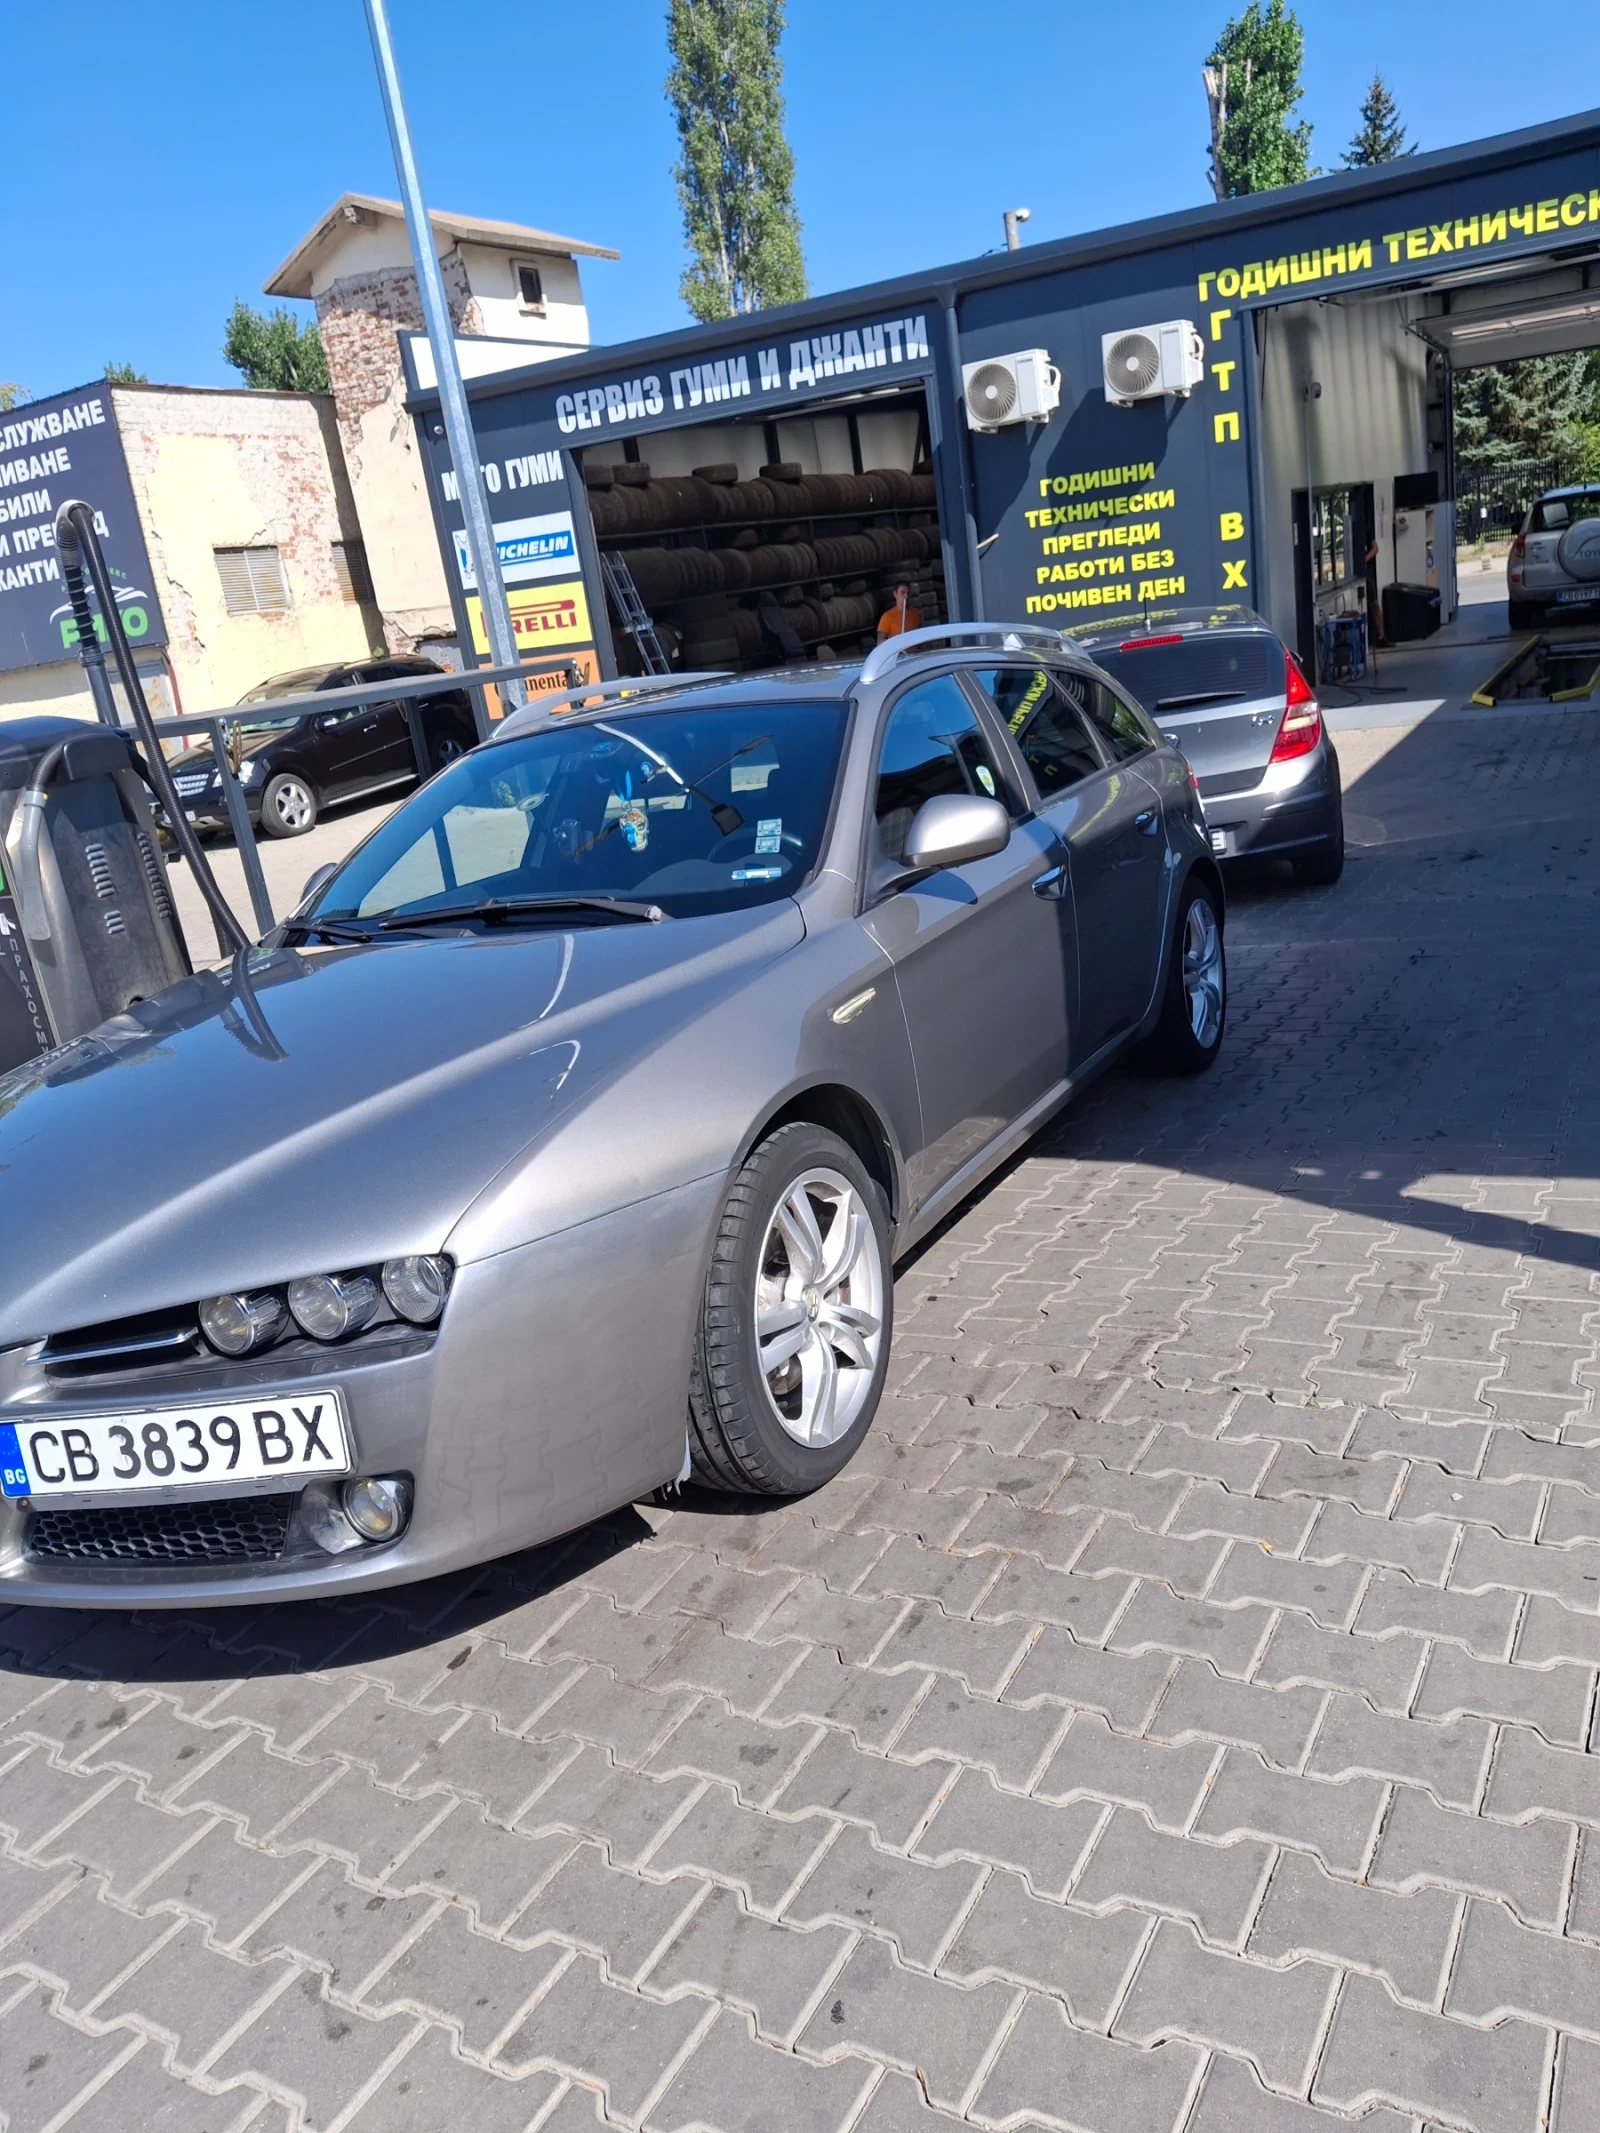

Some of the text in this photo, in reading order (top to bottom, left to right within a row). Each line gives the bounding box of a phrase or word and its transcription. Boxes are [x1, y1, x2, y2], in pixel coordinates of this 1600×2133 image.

[1198, 239, 1372, 302] ГОДИШНИ
[555, 315, 929, 434] СЕРВИЗ ГУМИ И ДЖАНТИ
[0, 447, 71, 487] ИВАНЕ
[441, 450, 564, 501] МО ГУМИ
[1039, 462, 1155, 497] ГОДИШНИ
[1024, 489, 1175, 528] ТЕХНИЧЕСКИ
[12, 511, 110, 553] ПРЕД
[496, 536, 569, 560] ICHELIN
[1042, 522, 1161, 555] ПРЕГЛЕДИ
[1036, 549, 1175, 584] РАБОТИ БЕЗ
[1579, 549, 1600, 558] TOY
[1026, 576, 1186, 614] ПОЧИВЕН ДЕН
[480, 599, 577, 638] PRELLI
[108, 1416, 241, 1479] 3839
[4, 1468, 27, 1485] BG
